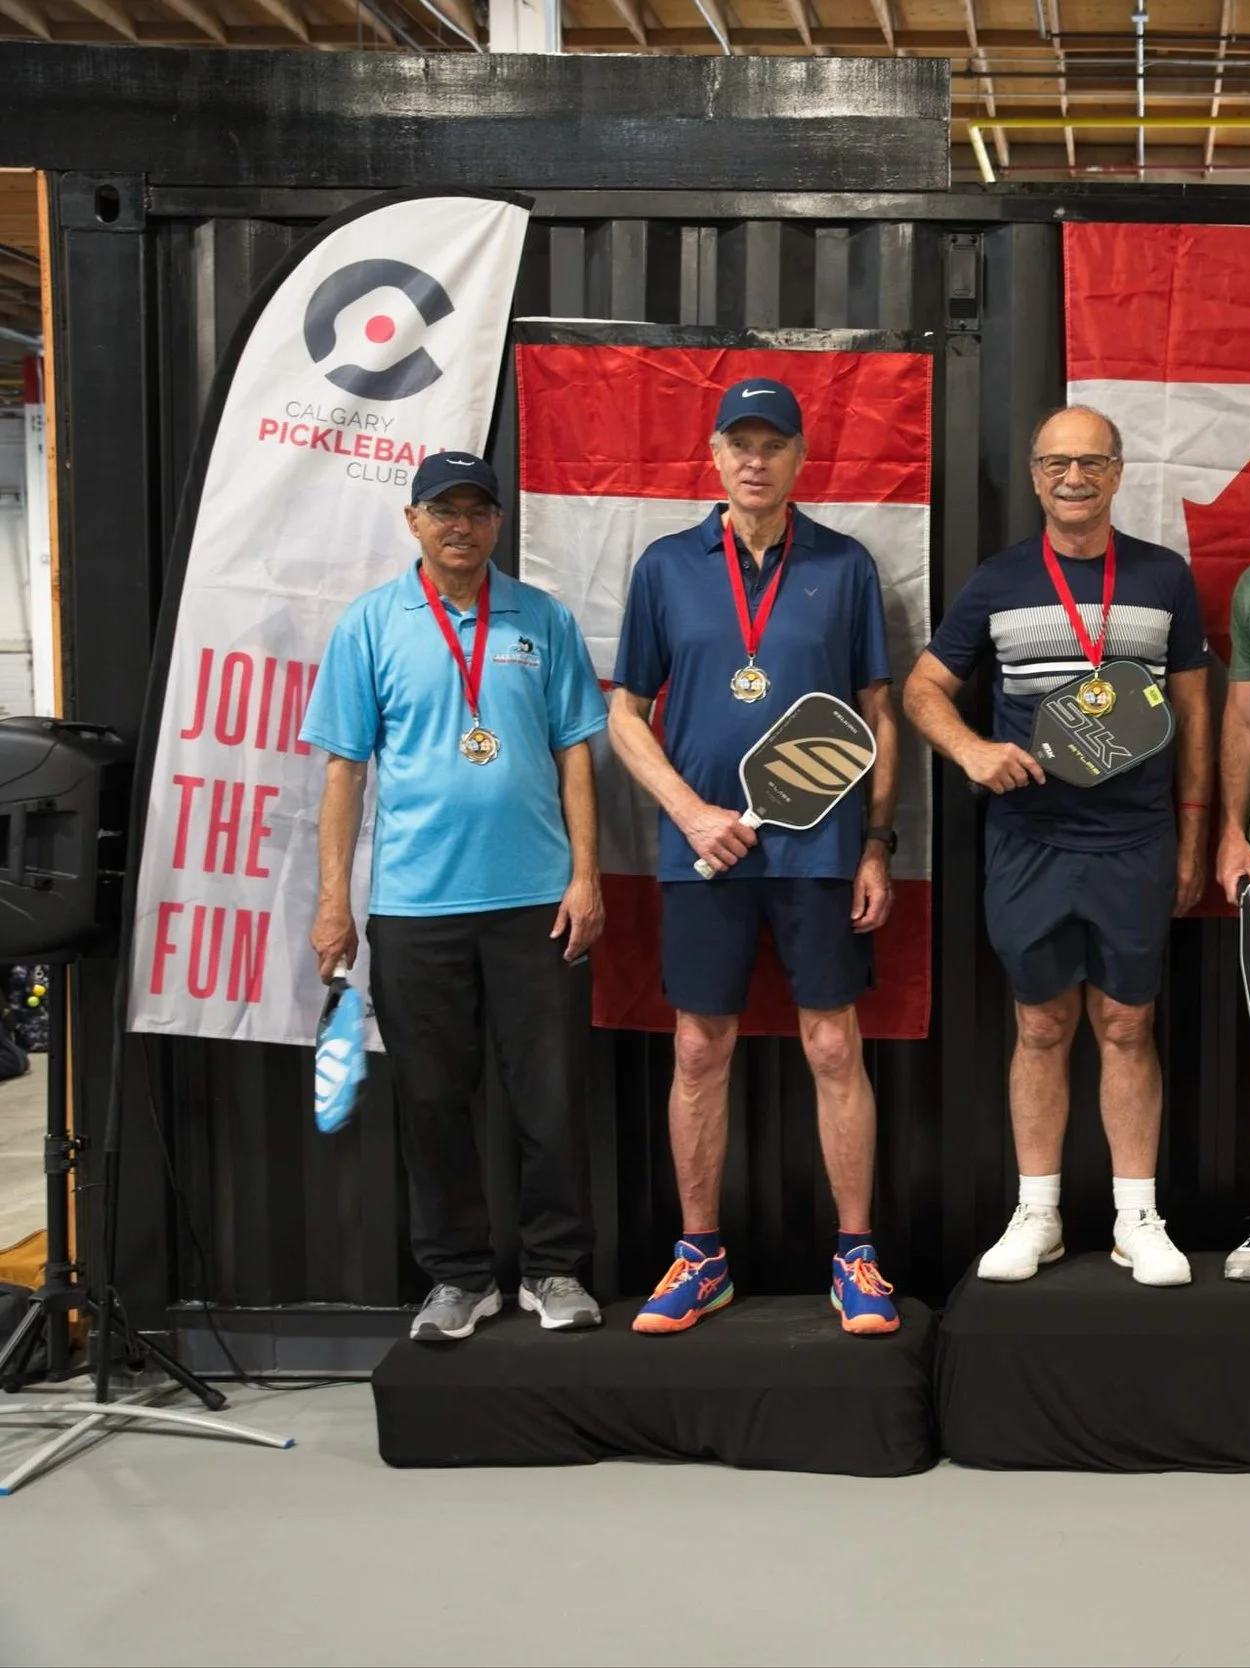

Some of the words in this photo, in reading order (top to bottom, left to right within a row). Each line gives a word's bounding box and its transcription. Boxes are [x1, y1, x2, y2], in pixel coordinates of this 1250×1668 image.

[258, 418, 445, 467] PICKLEBAL
[285, 401, 396, 433] CALGARY
[346, 462, 408, 487] CLUB
[180, 648, 320, 756] JOIN
[172, 774, 279, 879] THE
[149, 901, 271, 1003] FUN
